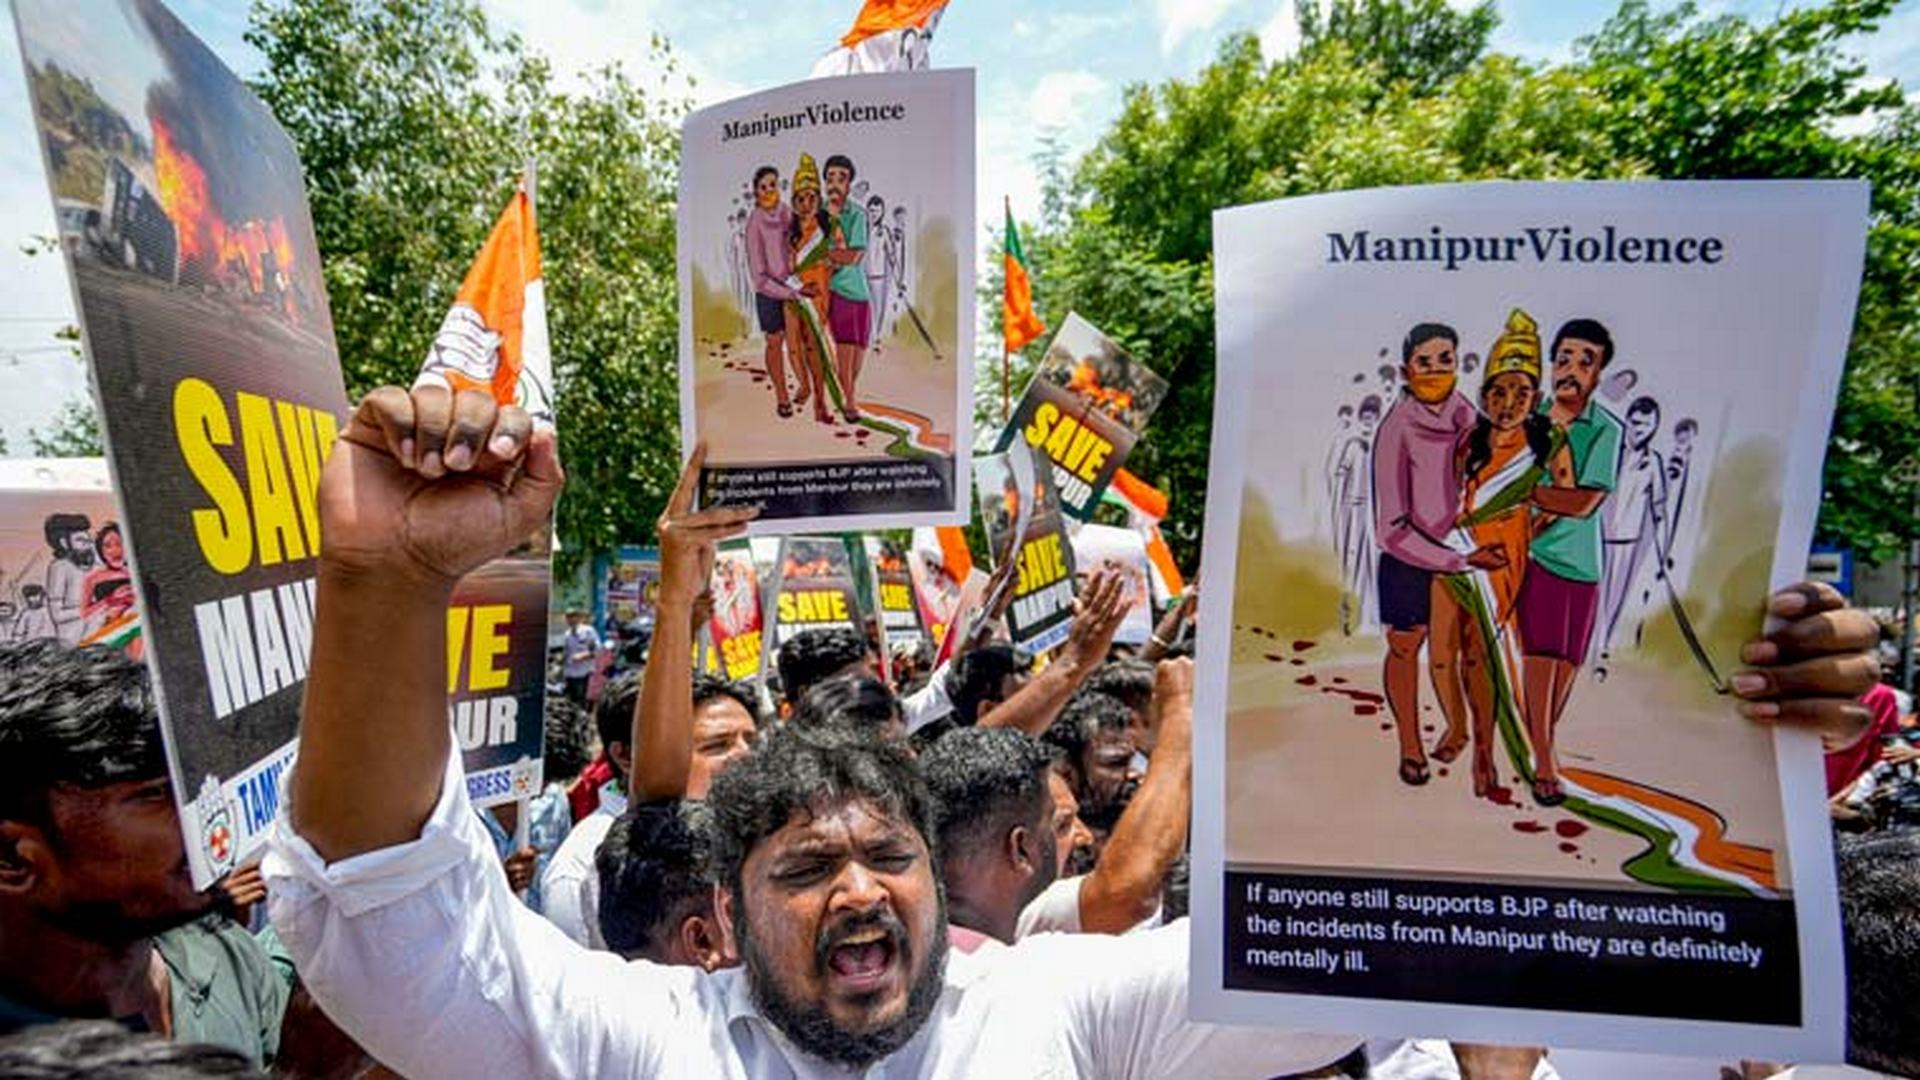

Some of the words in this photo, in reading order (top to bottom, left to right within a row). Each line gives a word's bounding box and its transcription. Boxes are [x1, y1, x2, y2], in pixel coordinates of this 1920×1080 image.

[722, 101, 905, 142] ManipurViolence
[1327, 226, 1723, 270] ManipurViolence
[1026, 402, 1113, 484] SAVE
[1014, 531, 1067, 595] SAVE
[779, 589, 849, 622] SAVE
[1246, 882, 1264, 903] If
[1267, 886, 1345, 910] anyone
[1350, 888, 1390, 909] still
[1395, 893, 1495, 917] supports
[1501, 896, 1549, 917] BJP
[1554, 899, 1610, 922] after
[1614, 904, 1726, 933] watching
[1246, 914, 1282, 936] the
[1286, 916, 1387, 941] incidents
[1392, 920, 1446, 944] from
[1451, 925, 1546, 953] Manipur
[1552, 930, 1602, 958] they
[1607, 937, 1646, 957] are
[1651, 936, 1763, 968] definitely
[1246, 947, 1340, 975] mentally
[1344, 950, 1370, 972] ill.
